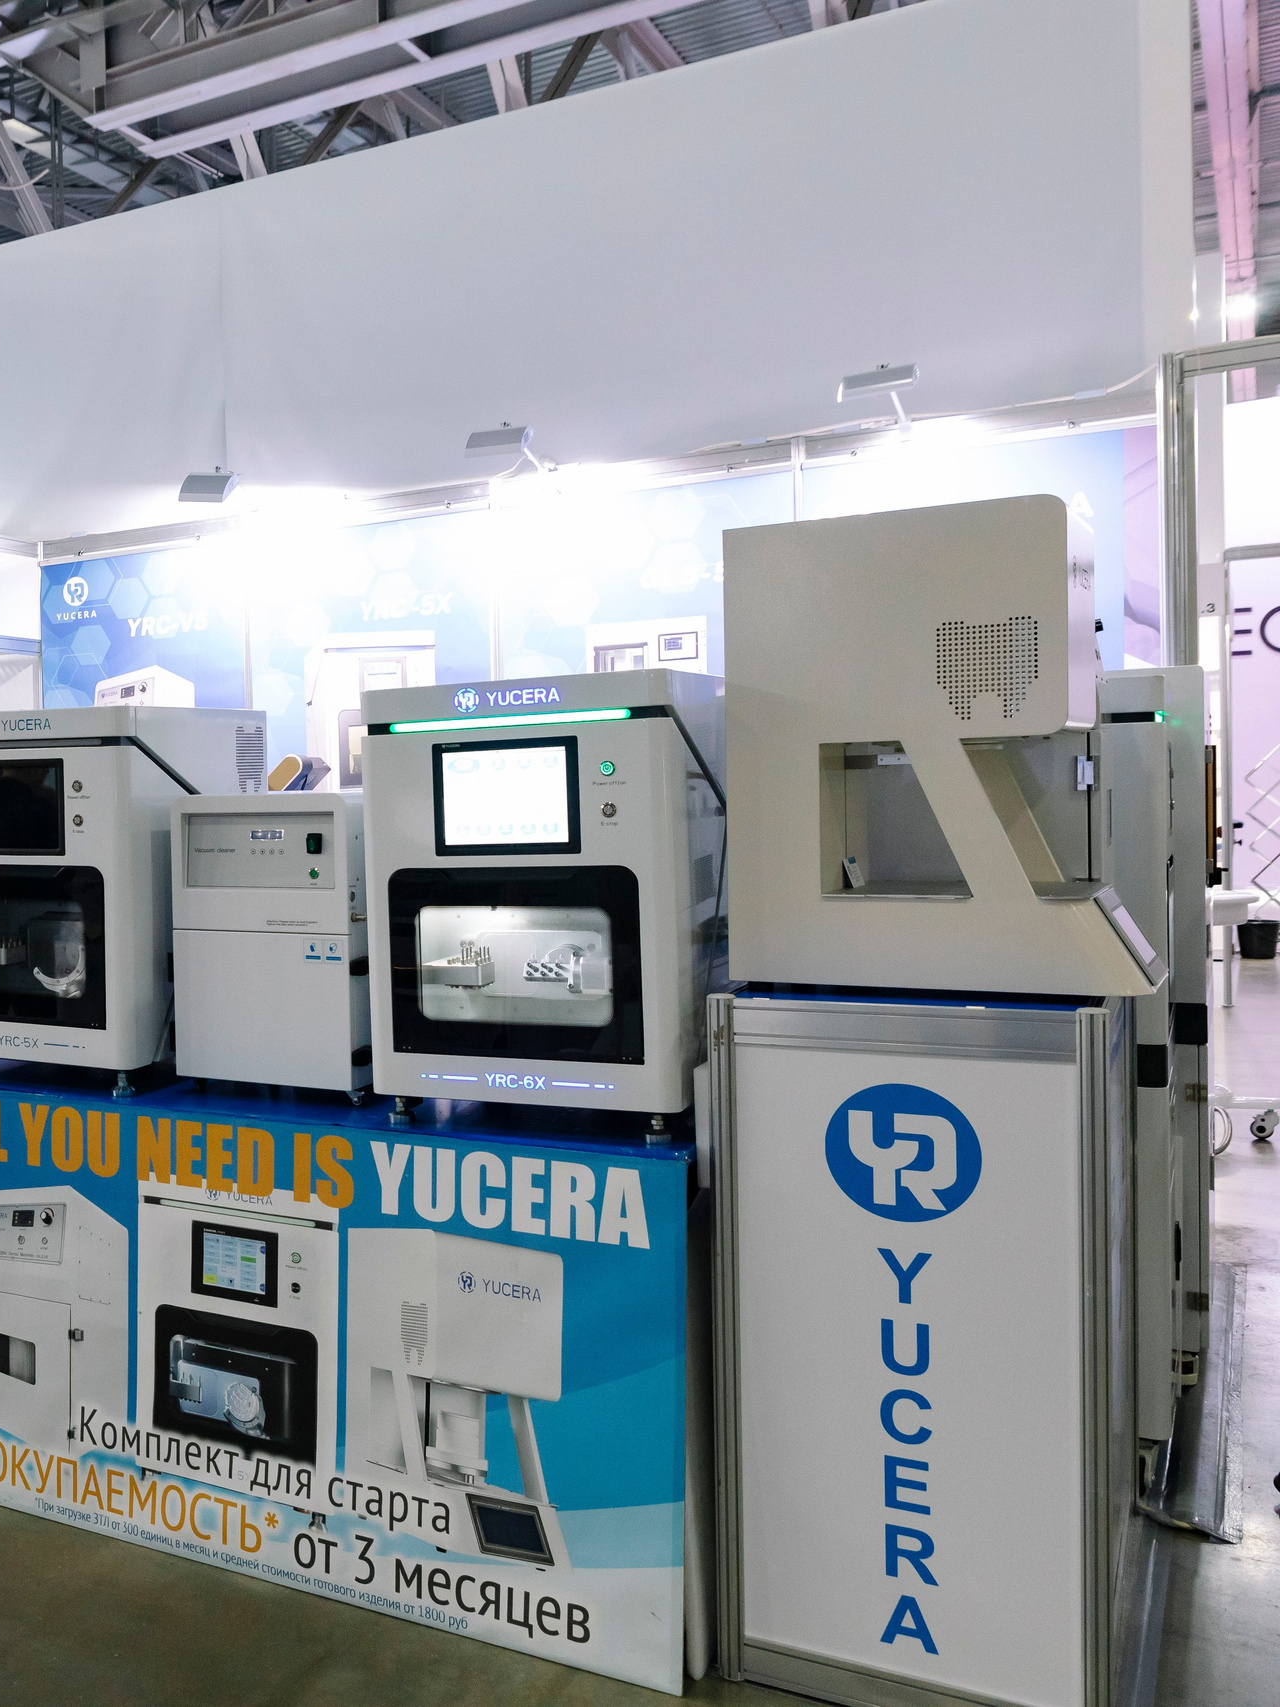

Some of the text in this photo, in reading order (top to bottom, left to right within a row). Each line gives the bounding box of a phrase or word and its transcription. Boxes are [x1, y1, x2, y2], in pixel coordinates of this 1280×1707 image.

[56, 610, 98, 622] YUCERA
[360, 591, 453, 621] YRC-5X
[127, 610, 209, 638] YRC-V5
[486, 686, 561, 708] YUCERA
[1, 717, 52, 732] YUCERA
[484, 1071, 547, 1091] YRC-6X
[19, 1102, 120, 1178] YOU
[136, 1115, 275, 1197] NEED
[293, 1132, 354, 1209] IS
[369, 1140, 651, 1250] YUCERA
[226, 1191, 273, 1206] YUCERA
[482, 1278, 542, 1303] YUCERA
[876, 1247, 939, 1655] YUCERA
[80, 1406, 451, 1535] Комплект для старта
[56, 1502, 91, 1523] загрузке
[111, 1520, 121, 1531] от
[122, 1521, 139, 1537] 300
[140, 1529, 174, 1548] единиц
[175, 1539, 181, 1548] в
[182, 1541, 211, 1559] месяц
[212, 1549, 219, 1559] и
[220, 1551, 259, 1572] средней
[261, 1563, 311, 1587] стоимости
[313, 1578, 356, 1599] готового
[358, 1590, 401, 1612] изделия
[403, 1604, 415, 1615] от
[418, 1604, 446, 1624] 1800
[448, 1614, 468, 1630] руб
[293, 1532, 592, 1644] от 3 месяцев
